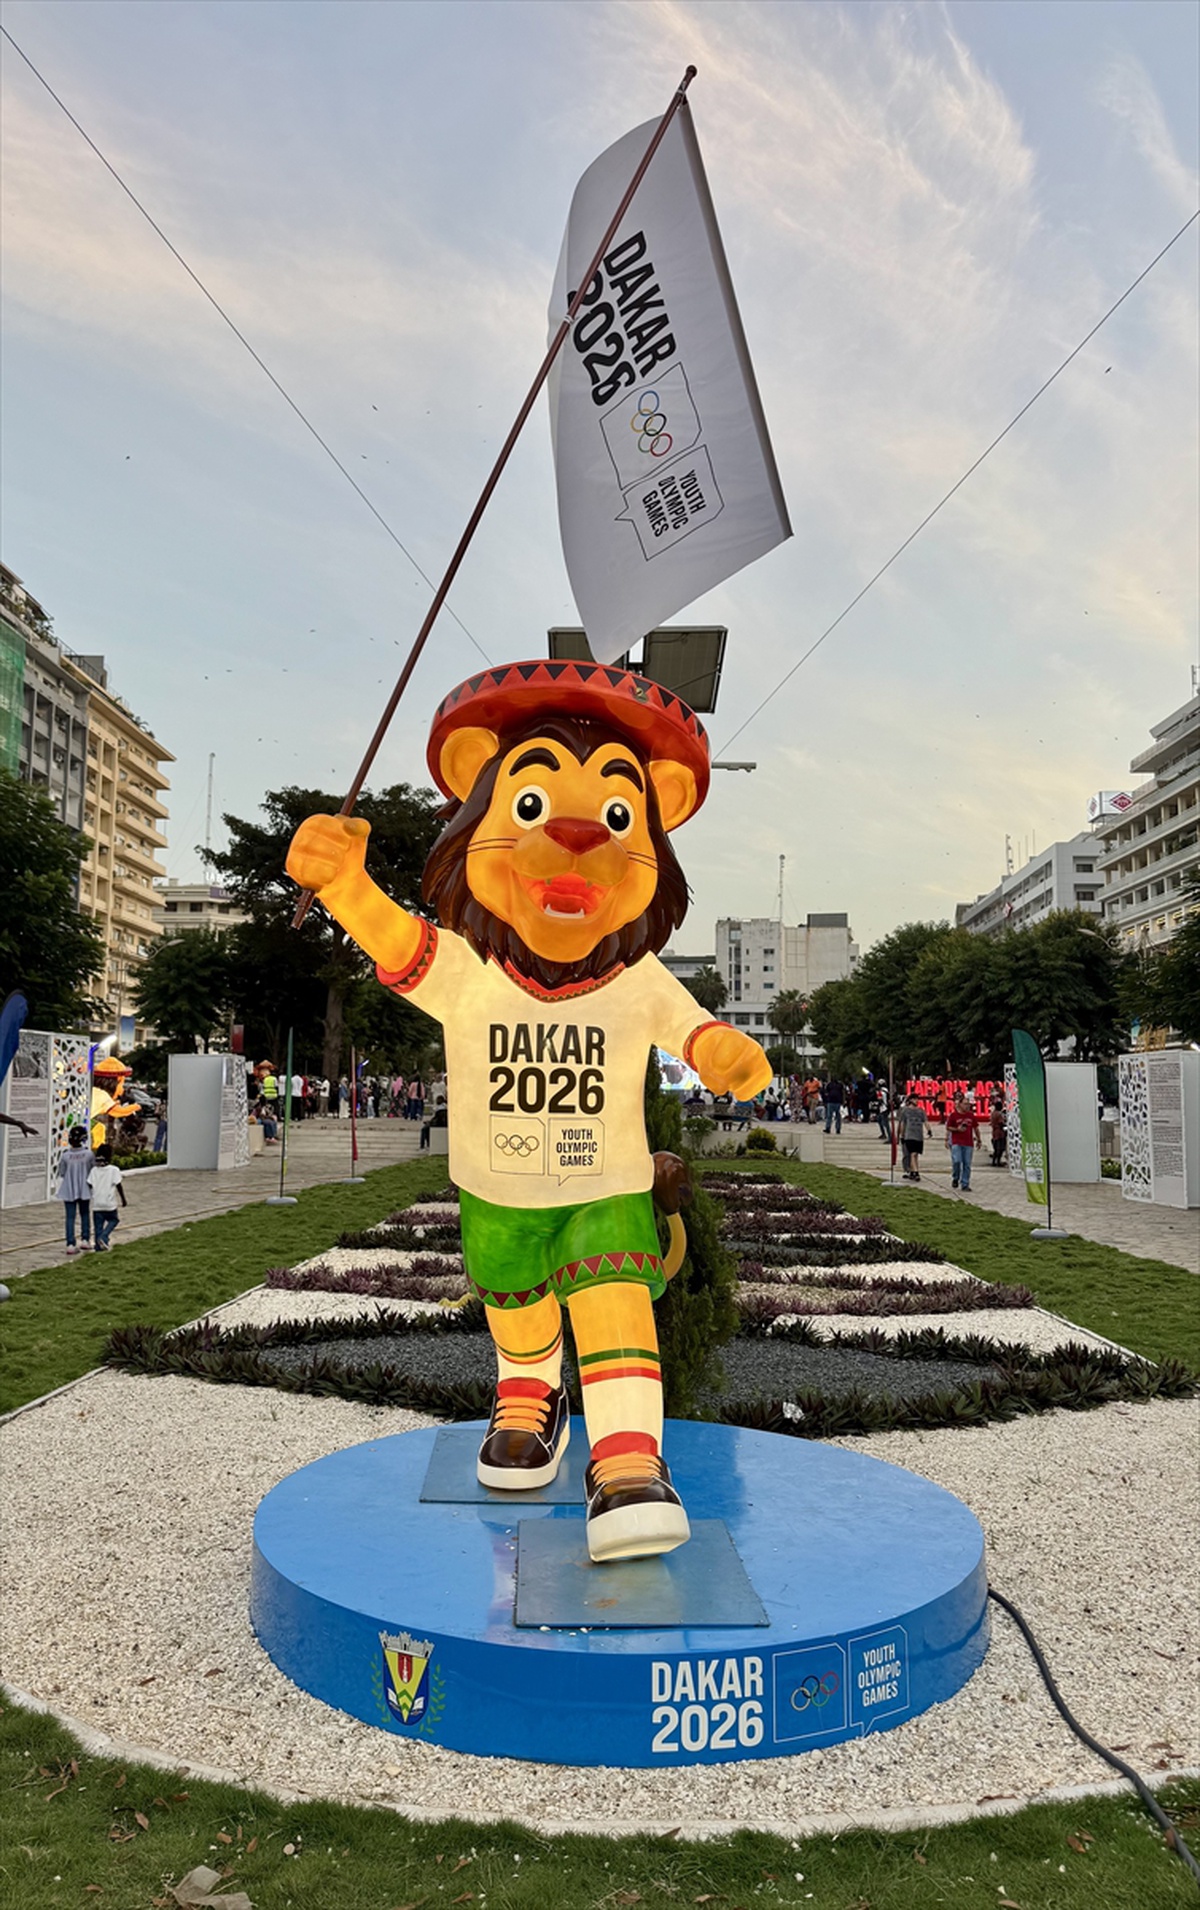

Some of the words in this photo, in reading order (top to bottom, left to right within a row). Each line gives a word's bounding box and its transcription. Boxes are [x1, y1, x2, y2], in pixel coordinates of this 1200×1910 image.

[603, 230, 677, 378] DAKAR
[642, 490, 669, 537] GAMES
[658, 475, 689, 530] OLYMPIC
[679, 469, 706, 514] YOUTH
[489, 1023, 606, 1066] DAKAR
[489, 1066, 605, 1115] 2026
[556, 1141, 598, 1154] OLYMPIC
[561, 1129, 593, 1140] YOUTH
[560, 1154, 594, 1167] GAMES
[857, 1659, 902, 1690] OLYMPIC
[863, 1643, 896, 1668] YOUTH
[651, 1656, 764, 1703] DAKAR
[862, 1681, 899, 1708] GAMES
[651, 1700, 764, 1753] 2026
